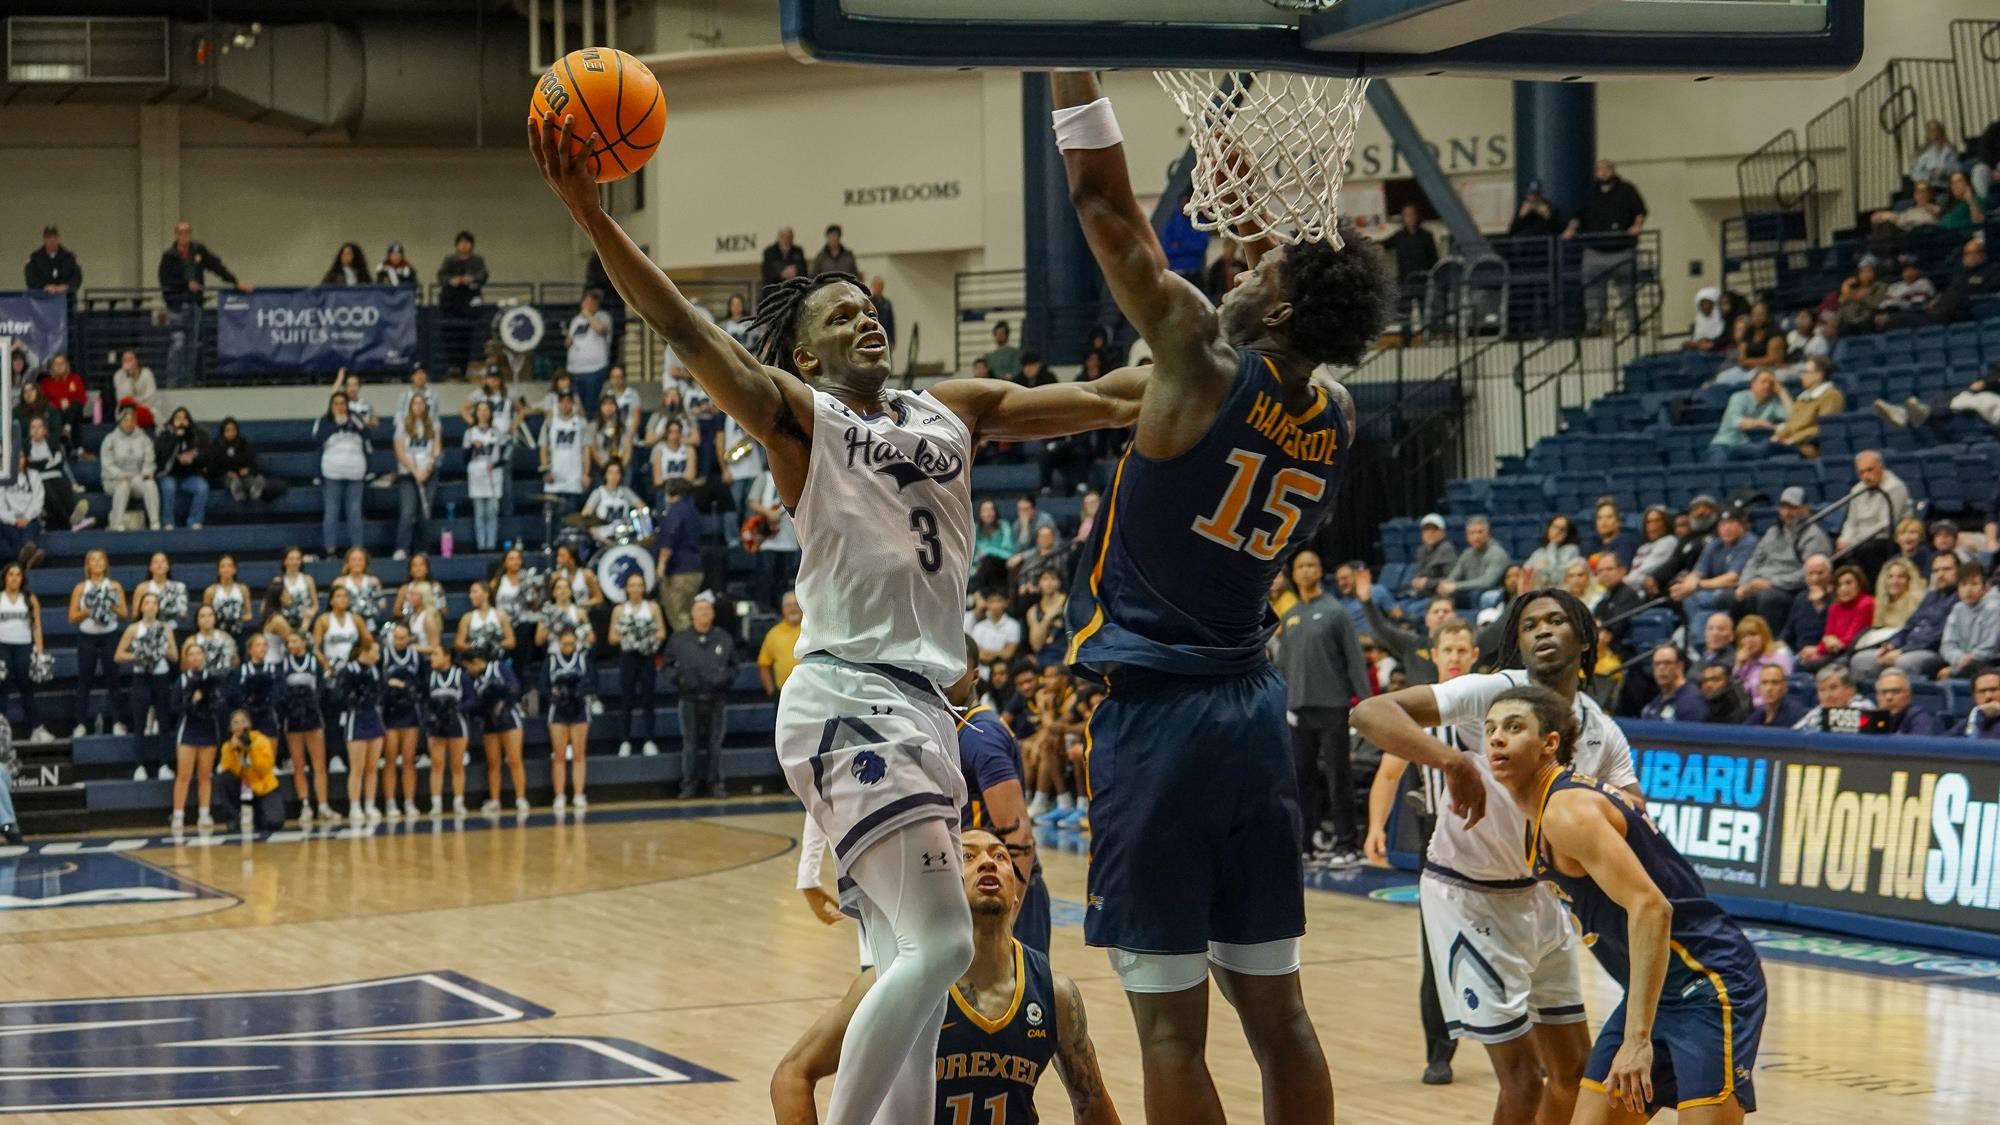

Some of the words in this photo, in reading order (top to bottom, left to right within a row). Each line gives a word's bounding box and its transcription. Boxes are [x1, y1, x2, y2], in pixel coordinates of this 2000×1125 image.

[843, 180, 961, 206] RESTROOMS
[715, 234, 758, 253] MEN
[256, 306, 380, 328] HOMEWOOD
[270, 327, 329, 344] SUITES
[922, 414, 942, 425] CAA
[556, 430, 576, 444] M
[667, 460, 687, 473] M
[606, 505, 625, 521] M
[1190, 448, 1326, 560] 15
[909, 506, 943, 575] 3
[41, 765, 59, 786] N
[1027, 1029, 1047, 1039] CAA
[945, 1092, 1009, 1125] 11
